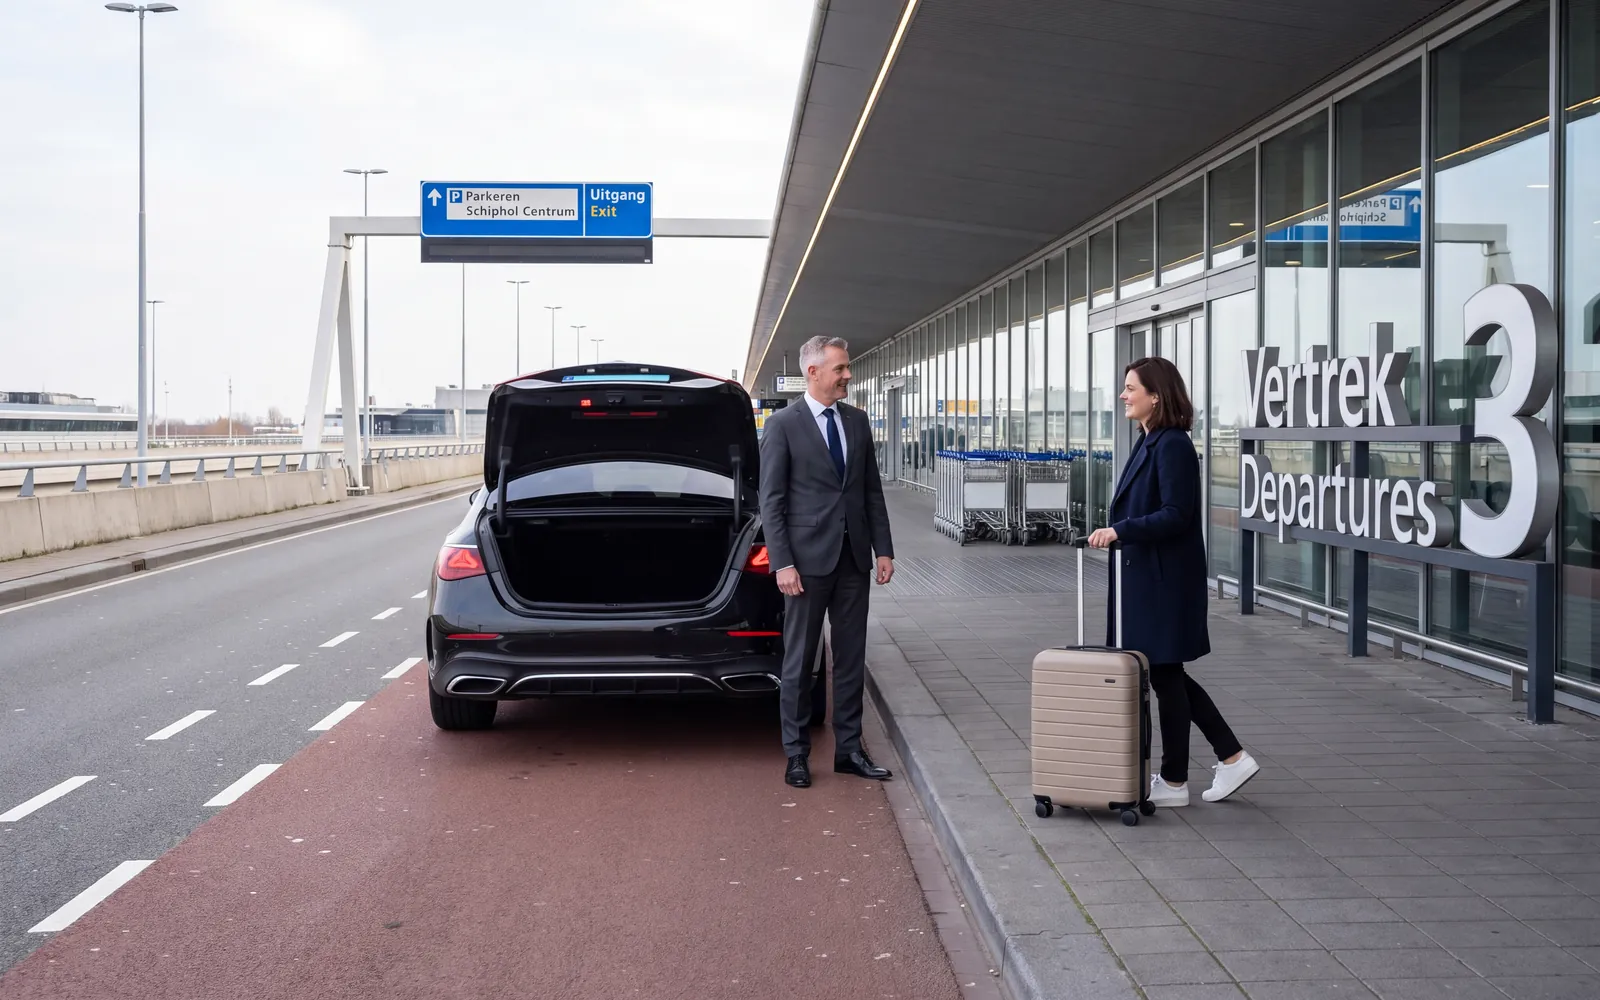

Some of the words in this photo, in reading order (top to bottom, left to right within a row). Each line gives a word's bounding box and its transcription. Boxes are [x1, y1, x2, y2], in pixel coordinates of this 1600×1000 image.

[451, 191, 460, 202] P
[466, 191, 520, 202] Parkeren
[590, 188, 646, 203] Uitgang
[466, 205, 518, 218] Schiphol
[523, 206, 575, 217] Centrum
[590, 206, 617, 217] Exit
[1241, 322, 1402, 428] Vertrek
[1460, 283, 1540, 560] 3
[1241, 453, 1443, 548] Departures
